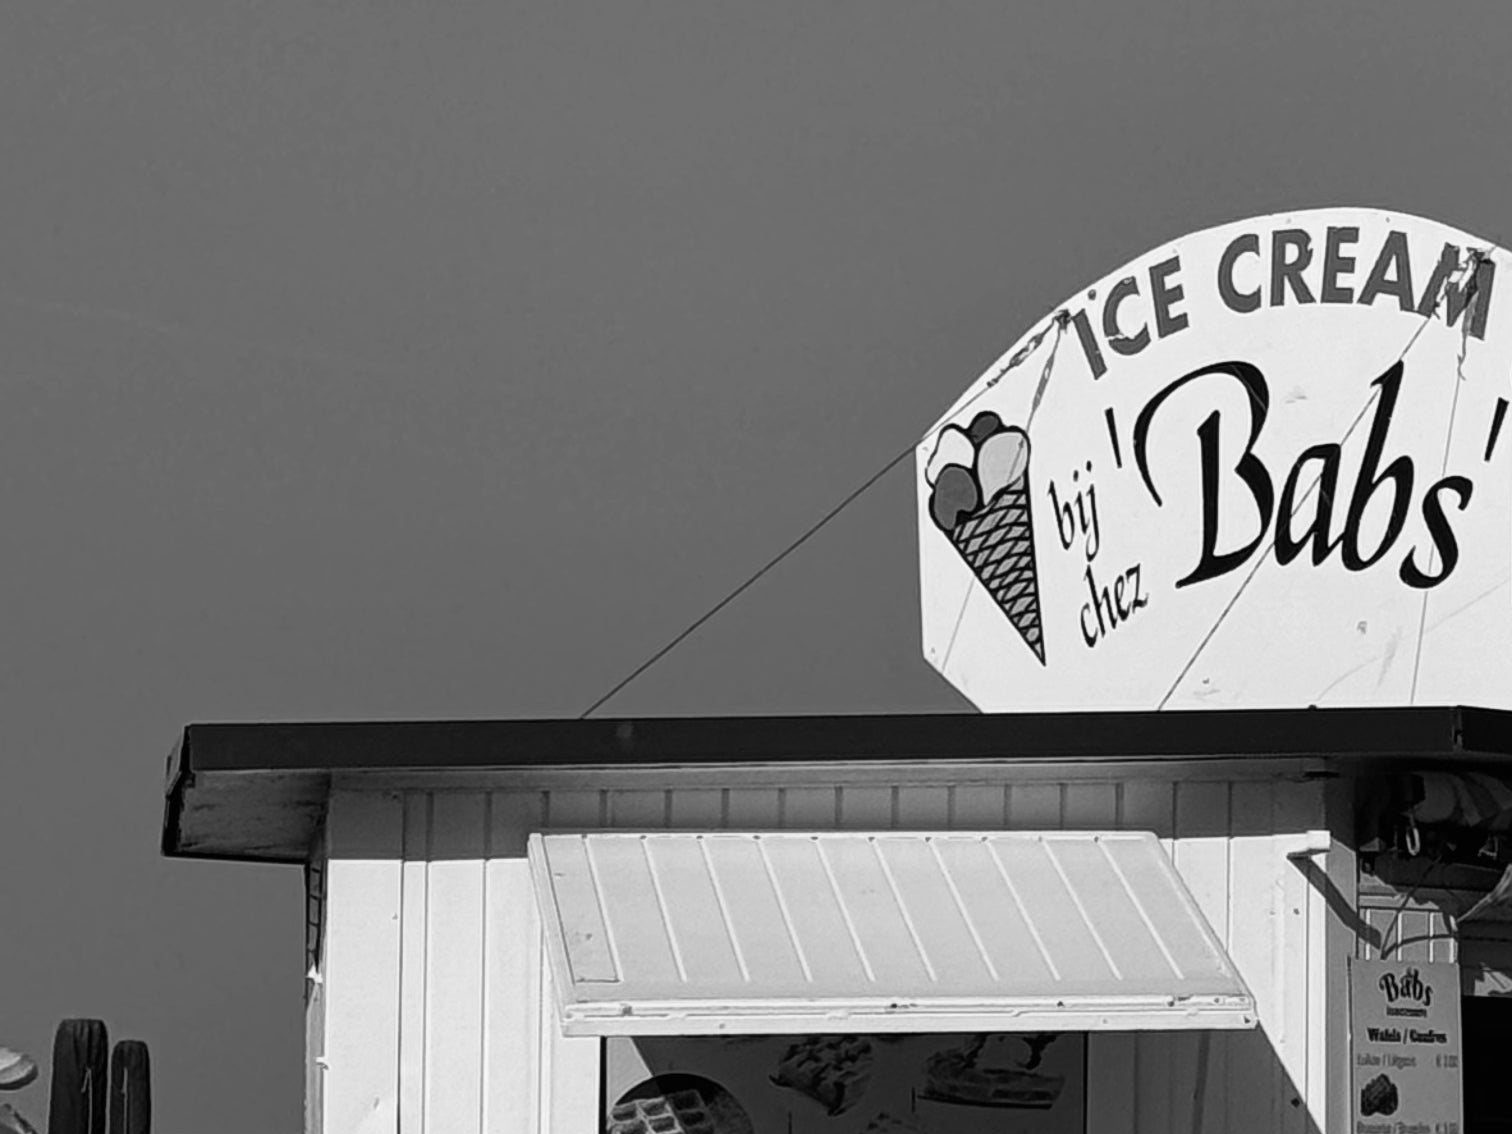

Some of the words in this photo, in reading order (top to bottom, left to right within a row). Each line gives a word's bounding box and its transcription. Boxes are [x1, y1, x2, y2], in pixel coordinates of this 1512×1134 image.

[1072, 256, 1189, 380] ICE
[1216, 225, 1497, 341] CREAM
[1048, 460, 1101, 562] bij
[1079, 562, 1149, 648] chez
[1378, 966, 1434, 1007] Babs
